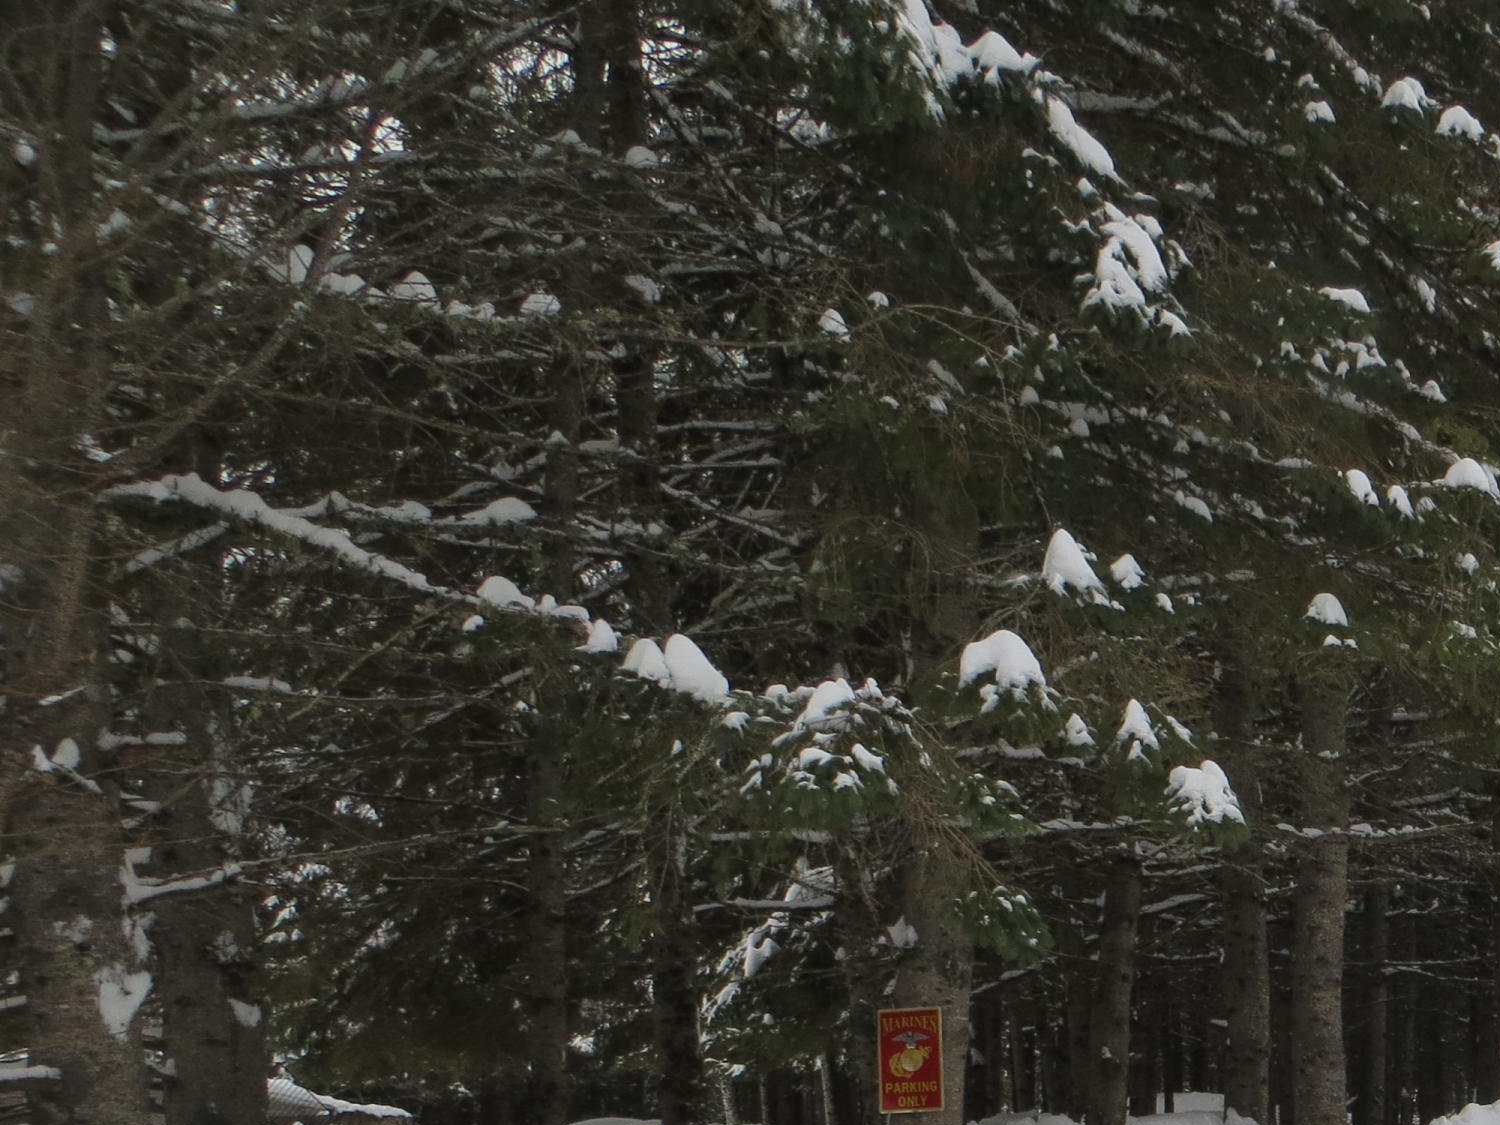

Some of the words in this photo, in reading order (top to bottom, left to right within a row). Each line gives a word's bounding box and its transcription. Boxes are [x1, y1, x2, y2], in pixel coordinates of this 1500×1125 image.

[882, 1015, 937, 1033] MARINES
[886, 1081, 937, 1093] PARKING
[898, 1095, 927, 1107] ONLY
